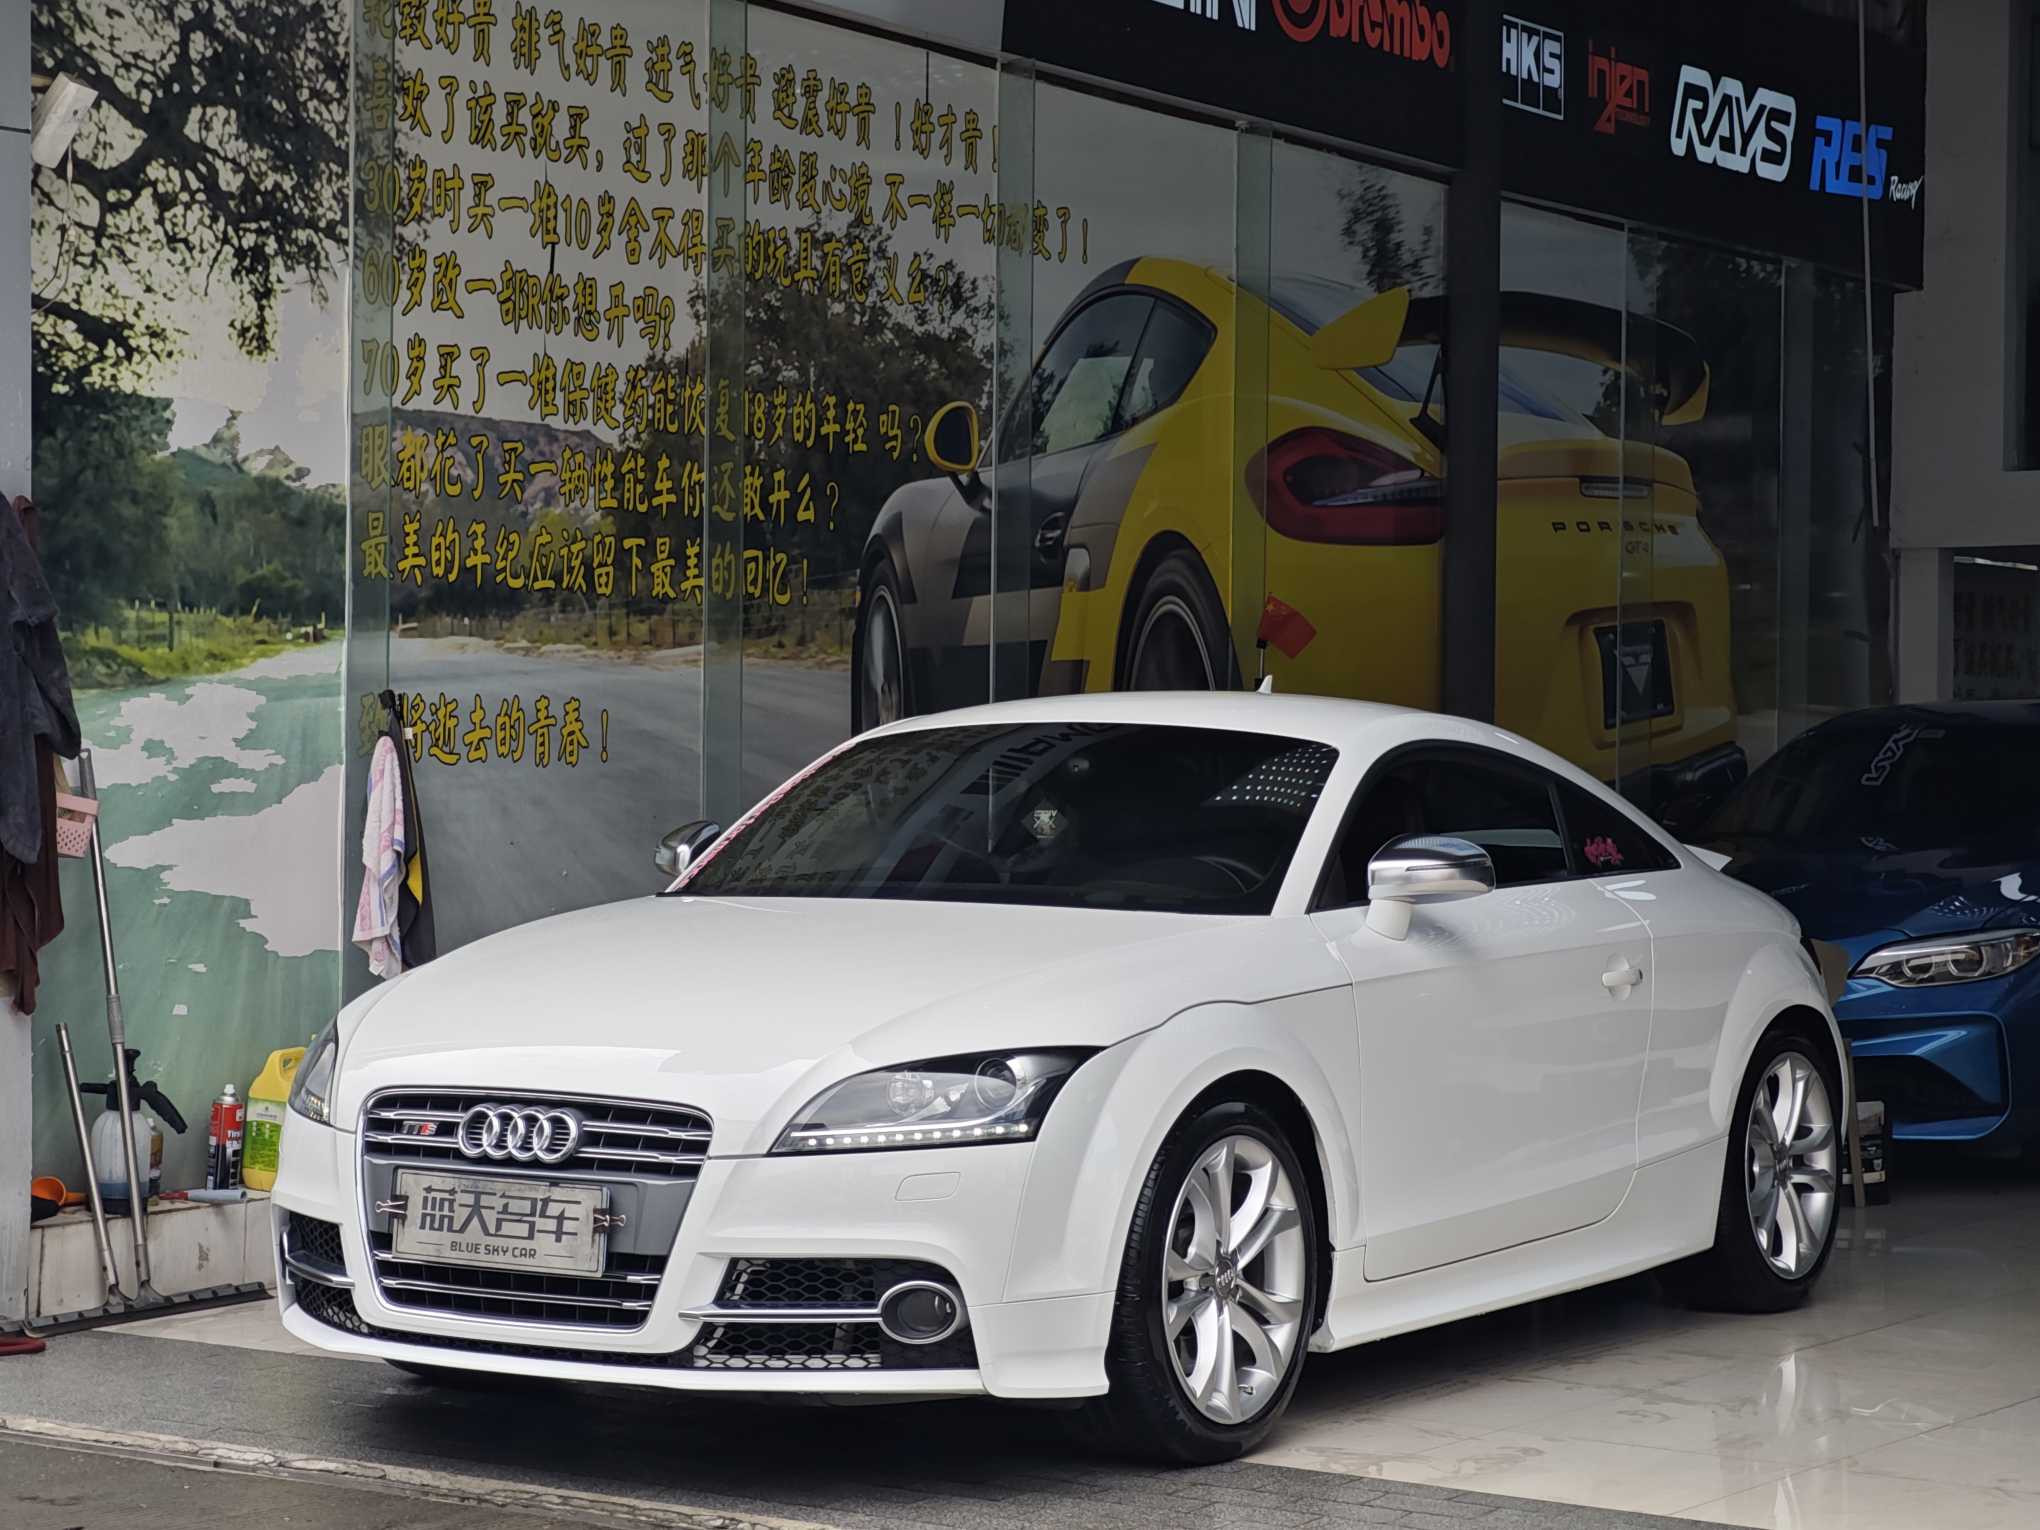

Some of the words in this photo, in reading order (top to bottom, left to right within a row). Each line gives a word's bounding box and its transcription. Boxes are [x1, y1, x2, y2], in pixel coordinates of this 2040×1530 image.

[511, 1, 633, 97] 排气好贵
[644, 35, 761, 124] 进气好贵
[1502, 22, 1563, 92] HKS
[1671, 64, 1797, 182] RAYS
[1808, 114, 1895, 200] RES
[1551, 521, 1679, 535] PORSCHE
[419, 1185, 582, 1243] 蓝天名车
[450, 1240, 481, 1254] BLUE
[484, 1244, 509, 1257] SKY
[511, 1247, 537, 1260] CAR
